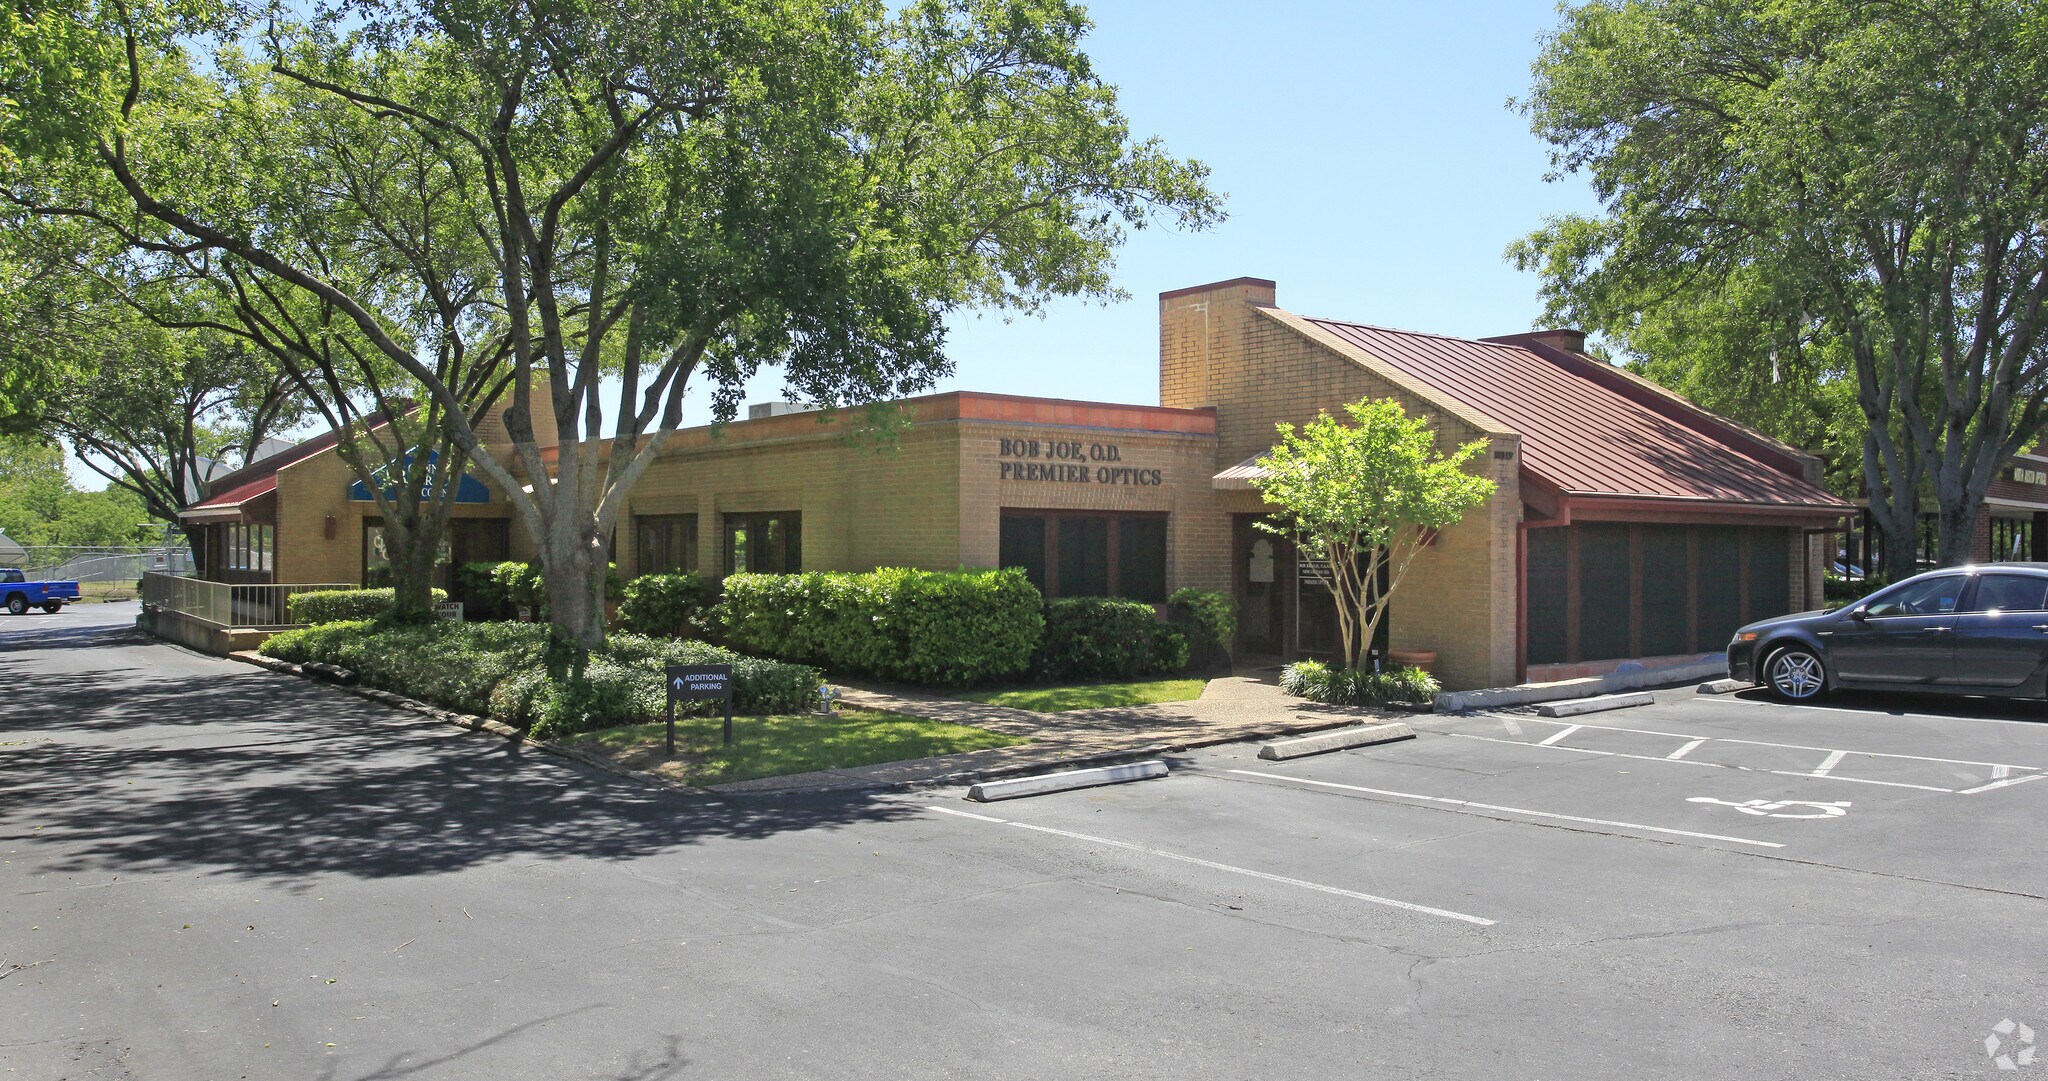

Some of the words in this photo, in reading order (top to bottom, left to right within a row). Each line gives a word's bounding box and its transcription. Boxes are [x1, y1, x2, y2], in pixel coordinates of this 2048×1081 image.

[1000, 438, 1040, 458] BOB
[1045, 441, 1087, 463] JOE,
[1090, 443, 1122, 462] O.D.
[1000, 461, 1091, 483] PREMIER
[1097, 466, 1162, 486] OPTICS
[684, 673, 728, 682] ADDITIONAL
[690, 682, 722, 690] PARKING
